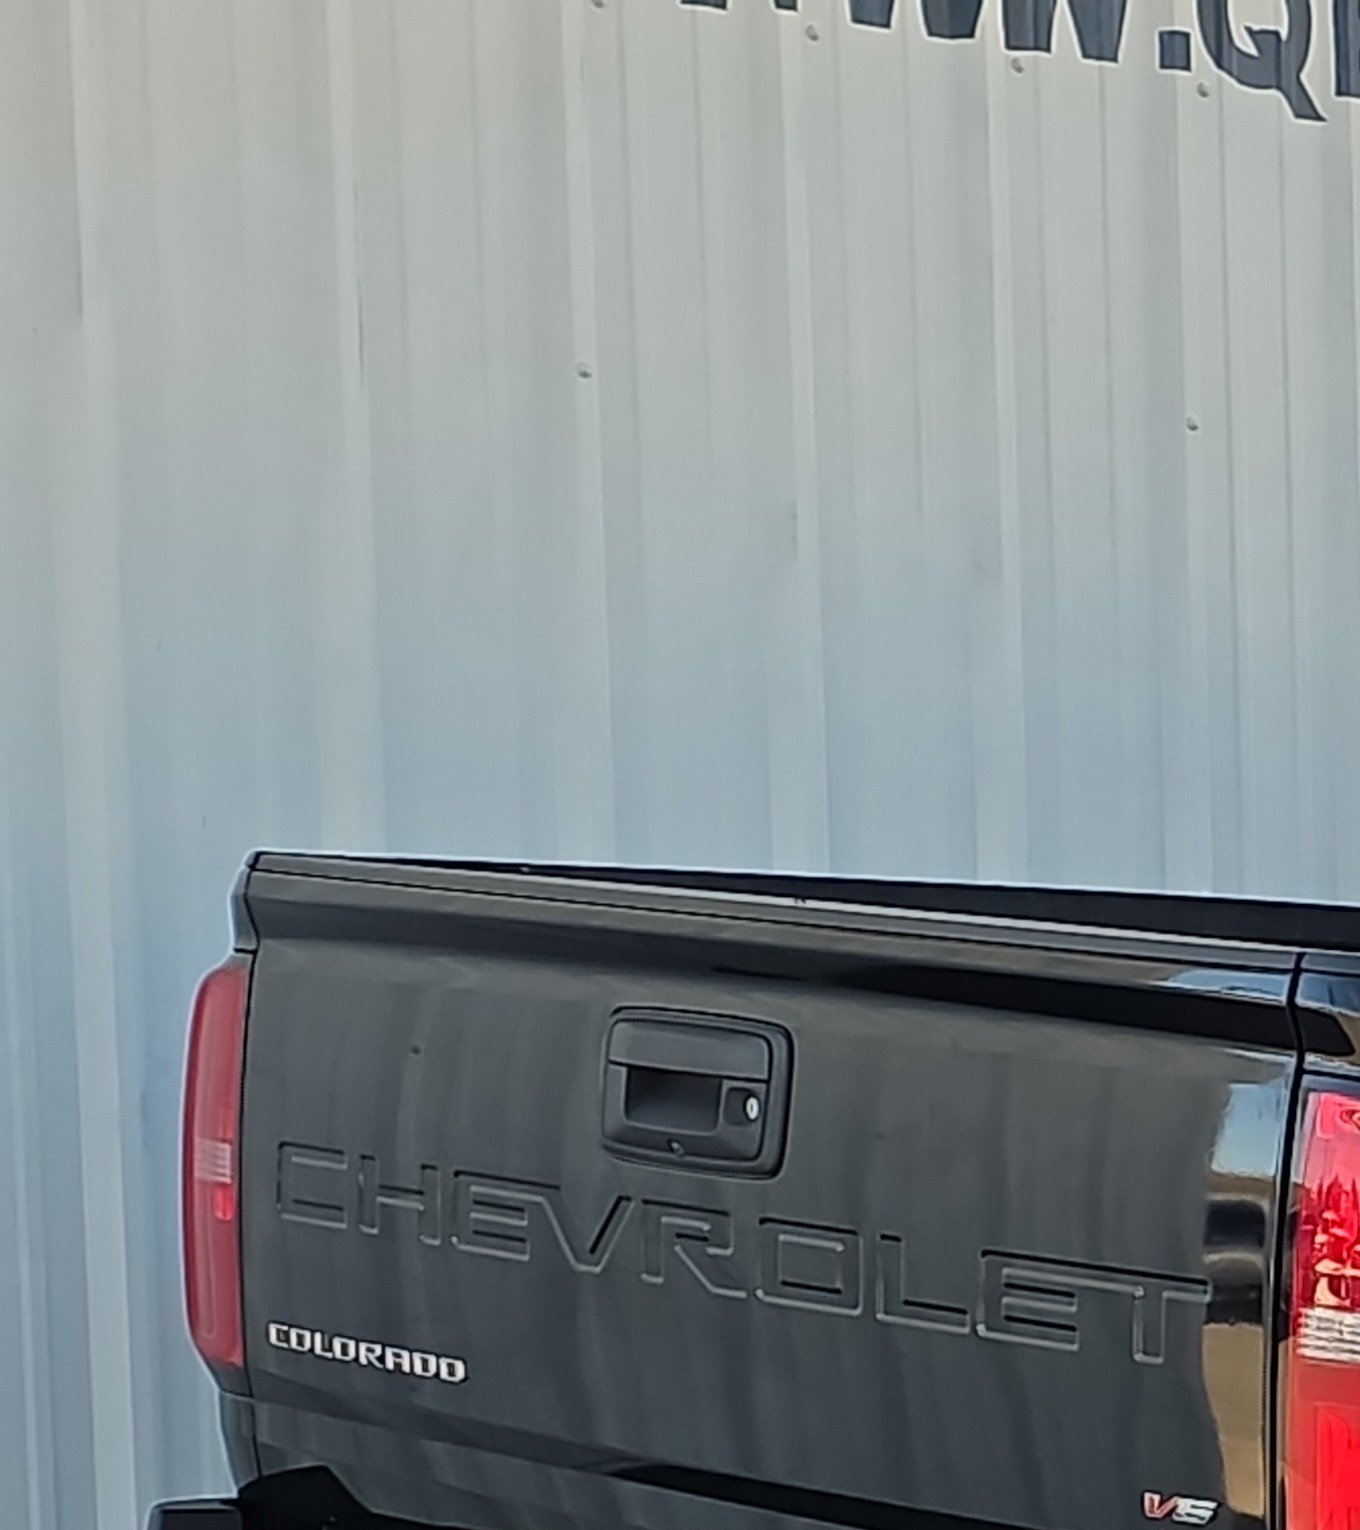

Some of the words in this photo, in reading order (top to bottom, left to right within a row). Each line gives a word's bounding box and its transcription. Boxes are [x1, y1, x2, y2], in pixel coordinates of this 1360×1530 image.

[276, 1139, 1213, 1365] CHEVROLET
[268, 1321, 468, 1384] COLORADO
[1143, 1490, 1219, 1526] V6
